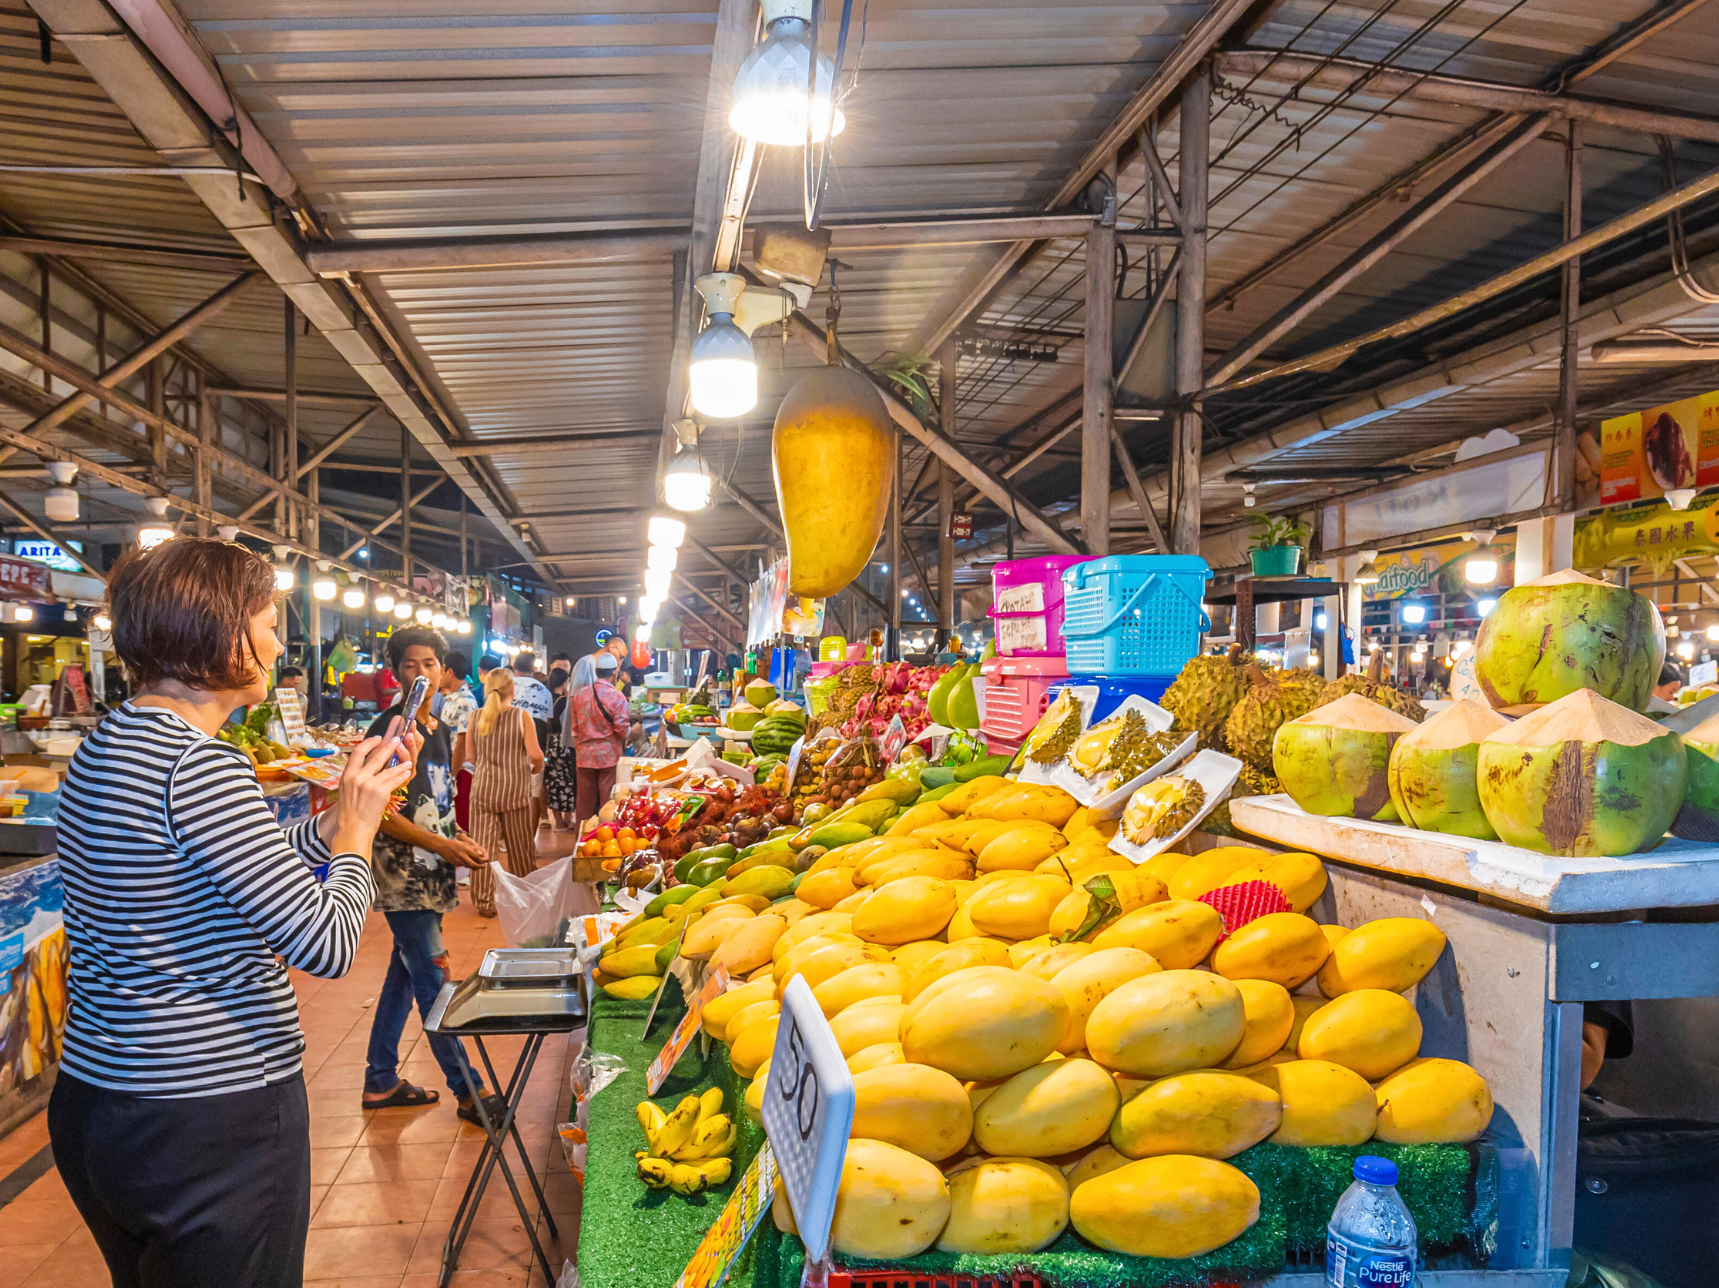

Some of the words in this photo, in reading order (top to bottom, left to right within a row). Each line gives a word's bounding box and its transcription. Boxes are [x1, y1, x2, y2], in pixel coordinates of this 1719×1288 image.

[1634, 521, 1696, 548] 泰國水果
[20, 546, 61, 557] ARITA
[1364, 558, 1430, 593] aifood
[779, 1014, 818, 1144] 50
[1360, 1266, 1393, 1284] Pure
[1394, 1270, 1412, 1288] Life
